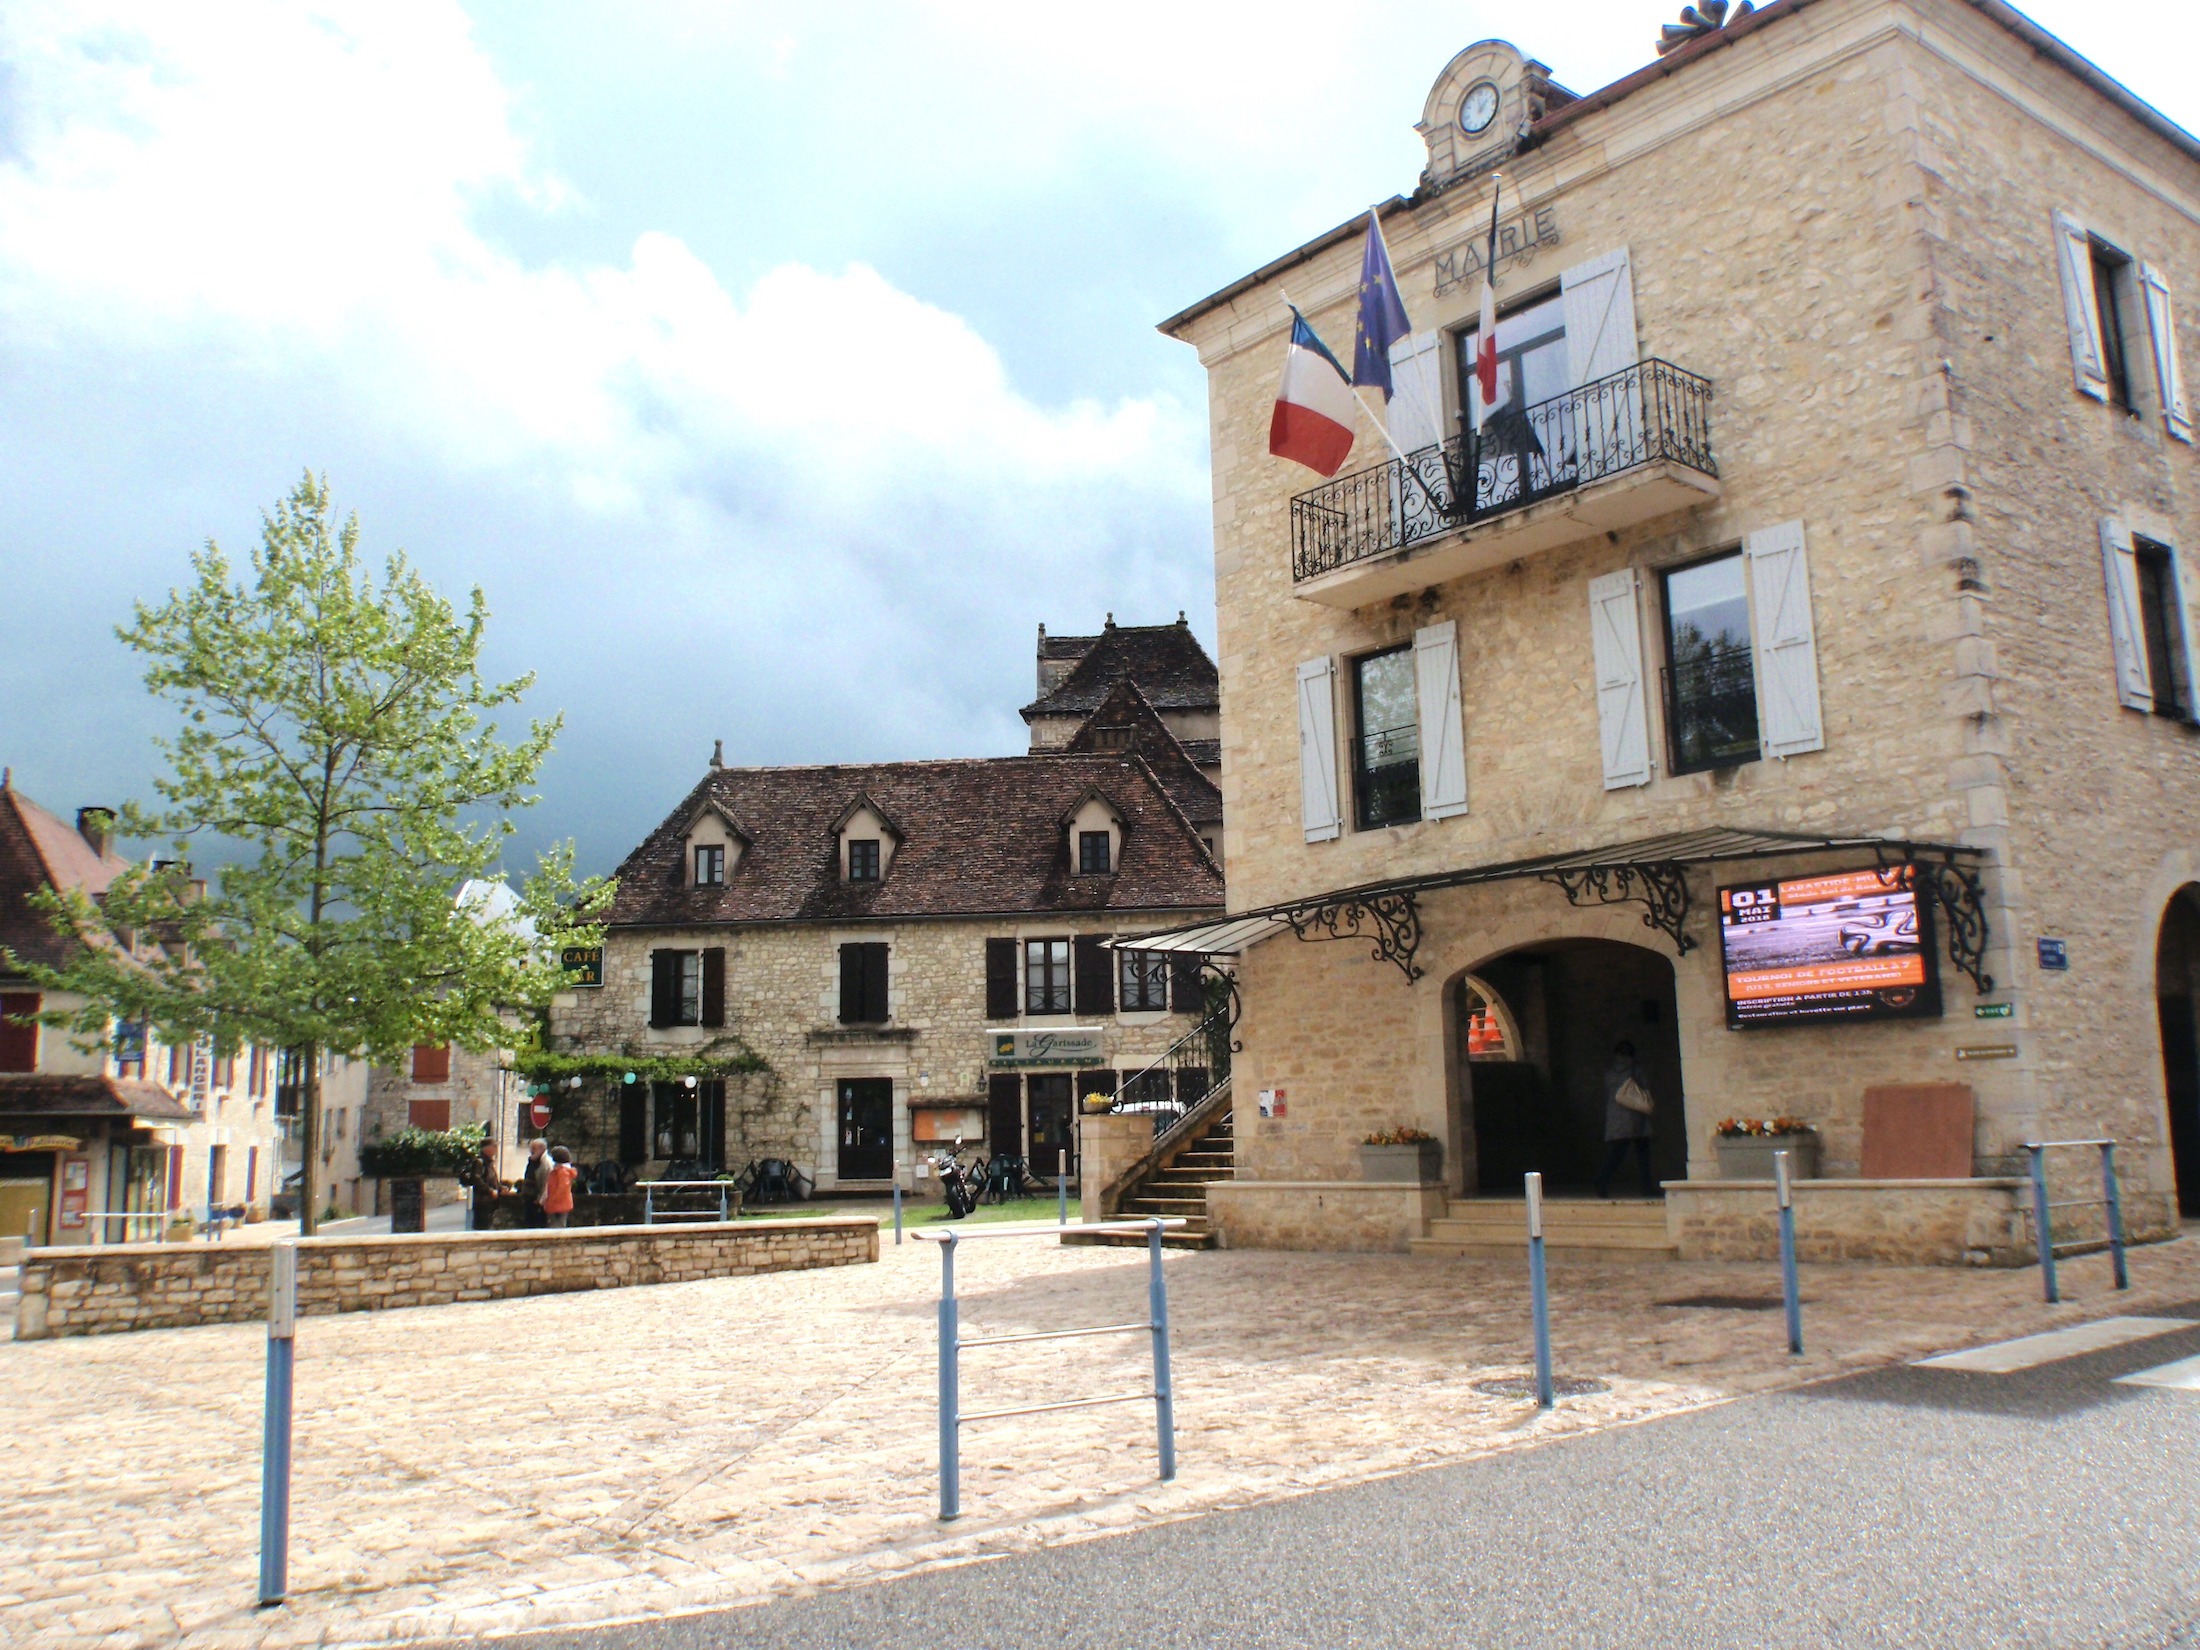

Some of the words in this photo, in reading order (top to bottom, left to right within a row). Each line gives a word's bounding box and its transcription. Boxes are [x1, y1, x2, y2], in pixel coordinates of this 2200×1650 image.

[1435, 206, 1555, 288] MARIE
[1732, 889, 1776, 908] 01
[1738, 905, 1771, 917] MAI
[1736, 973, 1792, 984] TOURNOI
[1819, 963, 1888, 976] FOOTBALL
[1902, 960, 1911, 969] 7
[1736, 996, 1794, 1006] INSCRIPTION
[1804, 992, 1837, 1000] PARTIR
[1838, 990, 1852, 998] DE
[1026, 1039, 1037, 1048] La
[990, 1057, 1105, 1067] RESTAURANT
